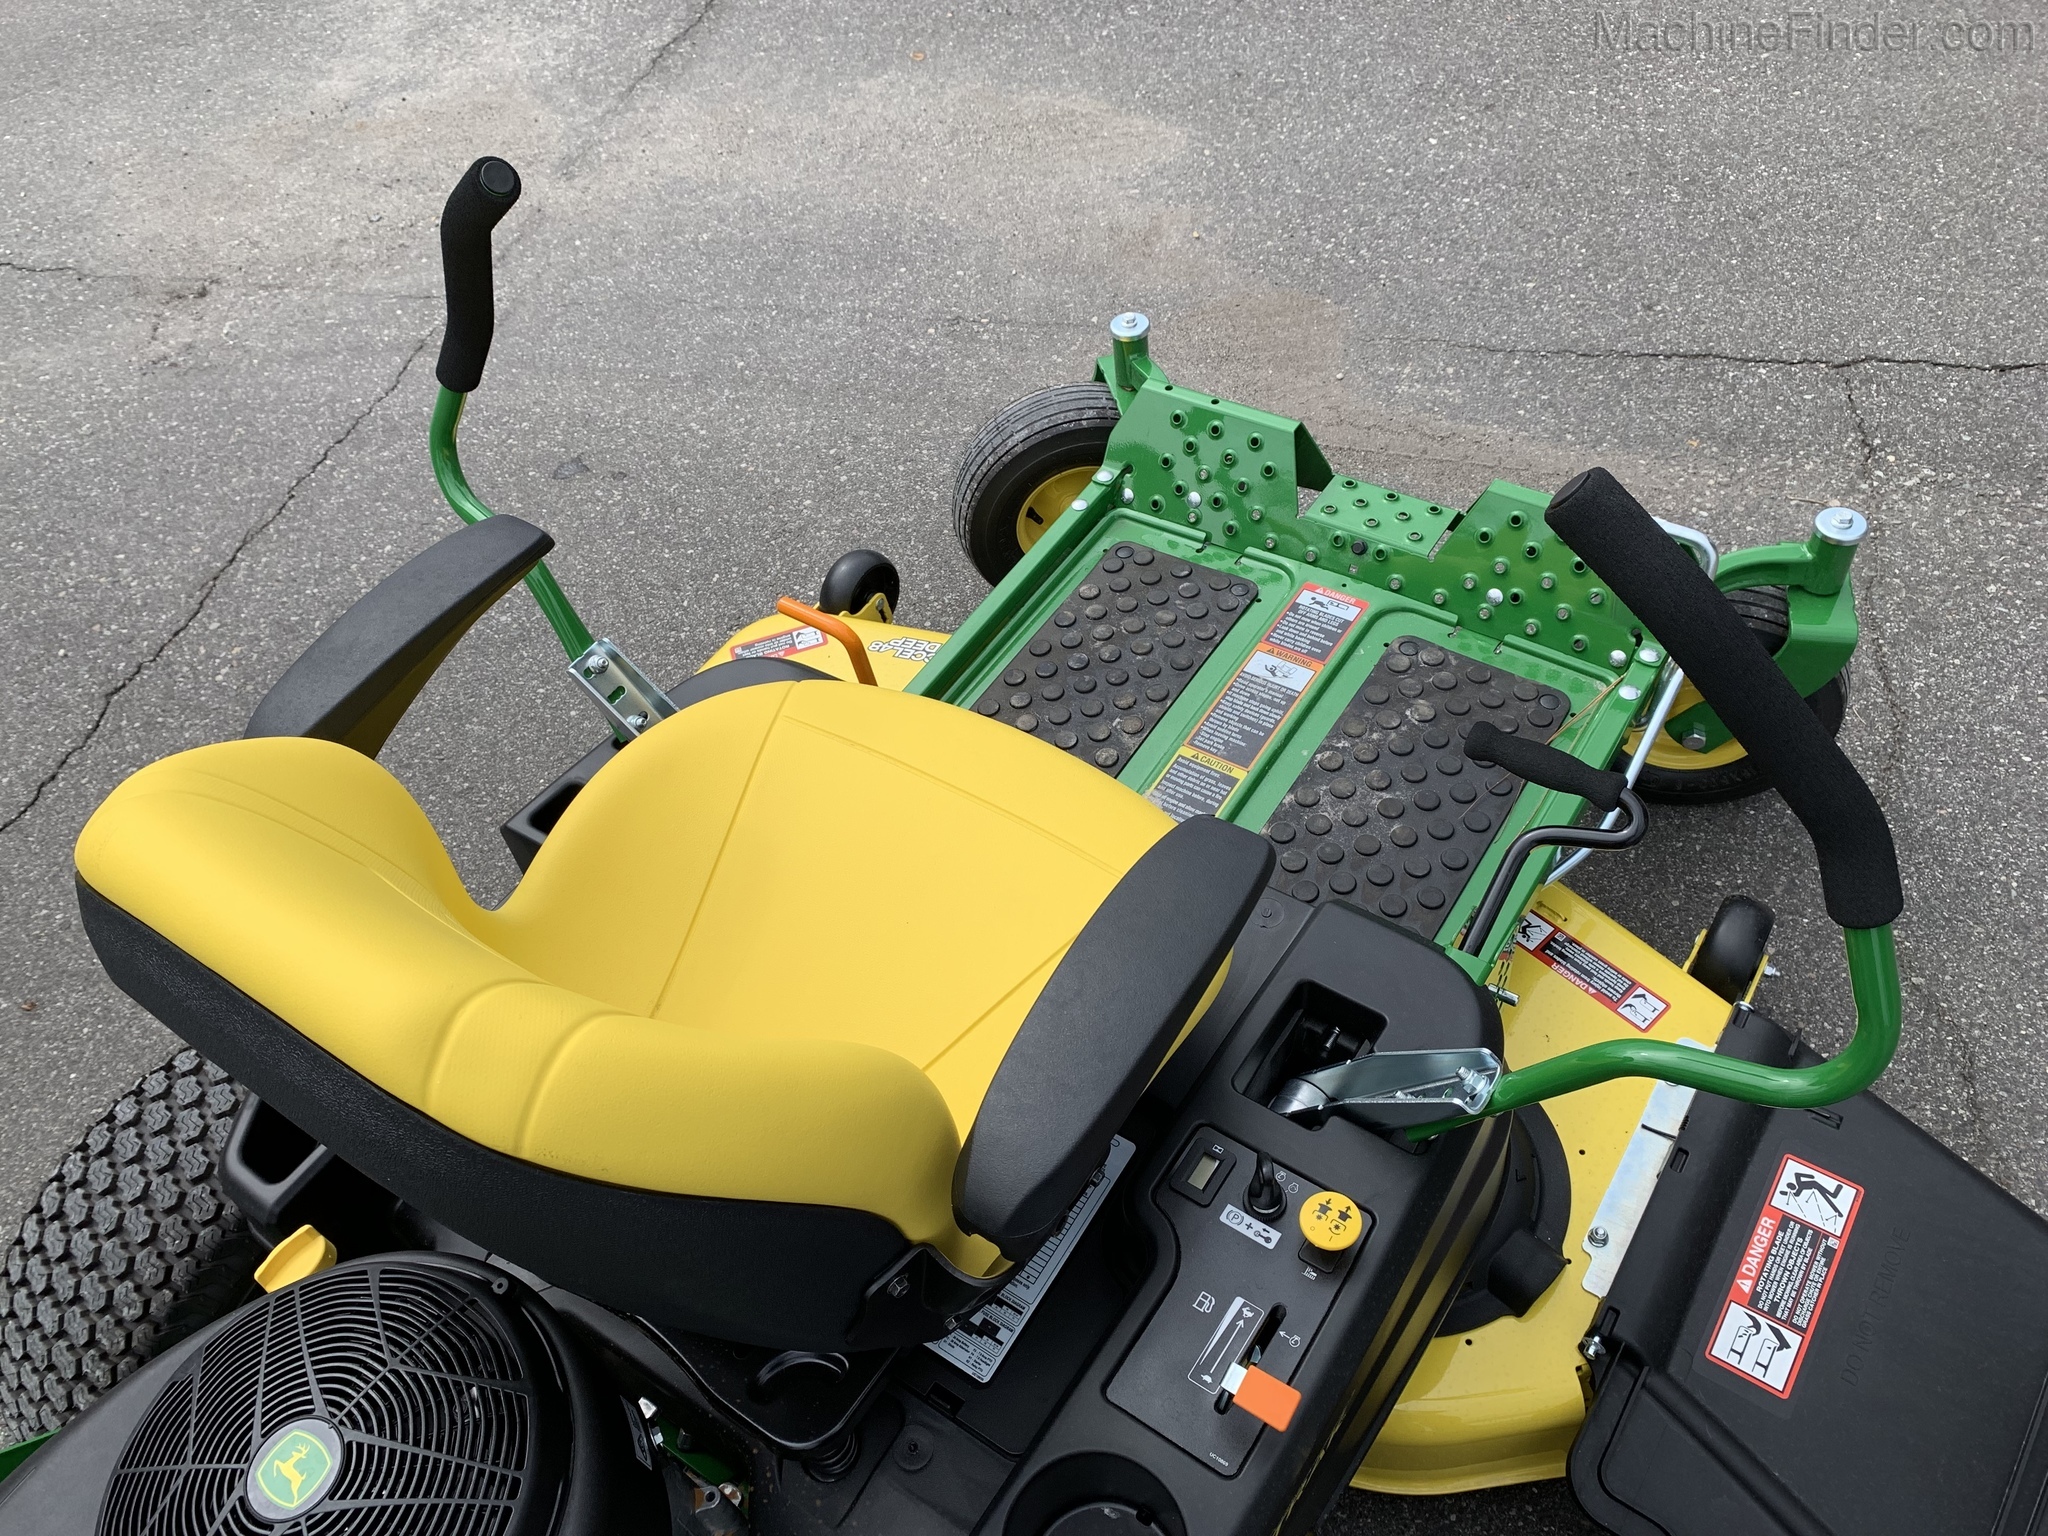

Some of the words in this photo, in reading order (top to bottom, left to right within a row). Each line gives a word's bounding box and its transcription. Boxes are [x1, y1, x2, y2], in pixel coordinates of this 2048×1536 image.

[1322, 589, 1356, 604] DANGER
[890, 636, 944, 652] DEEP
[1275, 649, 1313, 666] WARNING
[1199, 755, 1234, 773] CAUTION
[1550, 961, 1588, 990] DANGER
[1788, 1220, 1795, 1229] OR
[1782, 1228, 1792, 1244] UNDER
[1741, 1215, 1776, 1277] DANGER
[1777, 1243, 1786, 1256] FEET
[1803, 1246, 1813, 1263] BLADE
[1815, 1238, 1827, 1261] WITHOUT
[1755, 1254, 1775, 1292] ROTATING
[1770, 1229, 1784, 1255] BLADE
[1762, 1298, 1771, 1311] INTO
[1767, 1280, 1778, 1300] MOWER
[1774, 1266, 1784, 1281] WHEN
[1780, 1248, 1790, 1267] ENGINE
[1788, 1223, 1800, 1244] RUNNING
[1774, 1255, 1781, 1264] OR
[1800, 1262, 1807, 1270] BY
[1867, 1225, 1911, 1308] REMOVE
[1768, 1263, 1778, 1280] HANDS
[1773, 1269, 1790, 1303] THROWN
[1786, 1236, 1803, 1270] OBJECTS
[1775, 1298, 1786, 1318] BEFORE
[1782, 1279, 1794, 1300] MOWING,
[1789, 1265, 1799, 1281] CLEAR
[1795, 1253, 1803, 1266] AREA
[1801, 1228, 1813, 1249] OBJECTS
[1808, 1260, 1819, 1280] MOWER
[1792, 1269, 1804, 1290] THROWN
[1760, 1289, 1768, 1301] NOT
[1789, 1289, 1796, 1298] BE
[1796, 1297, 1810, 1326] DISCHARGE
[1806, 1281, 1816, 1298] CHUTE
[1813, 1273, 1819, 1282] OR
[1816, 1256, 1826, 1274] ENTIRE
[1799, 1279, 1812, 1304] OPERATE
[1801, 1310, 1811, 1328] GRASS
[1807, 1287, 1820, 1311] CATCHER
[1818, 1266, 1827, 1282] PLACE
[1757, 1300, 1764, 1308] DO
[1786, 1296, 1794, 1308] MAY
[1794, 1303, 1802, 1315] NOT
[1780, 1306, 1790, 1321] THAT
[1791, 1314, 1798, 1323] DO
[1851, 1308, 1882, 1353] NOT
[1838, 1352, 1866, 1388] DO
